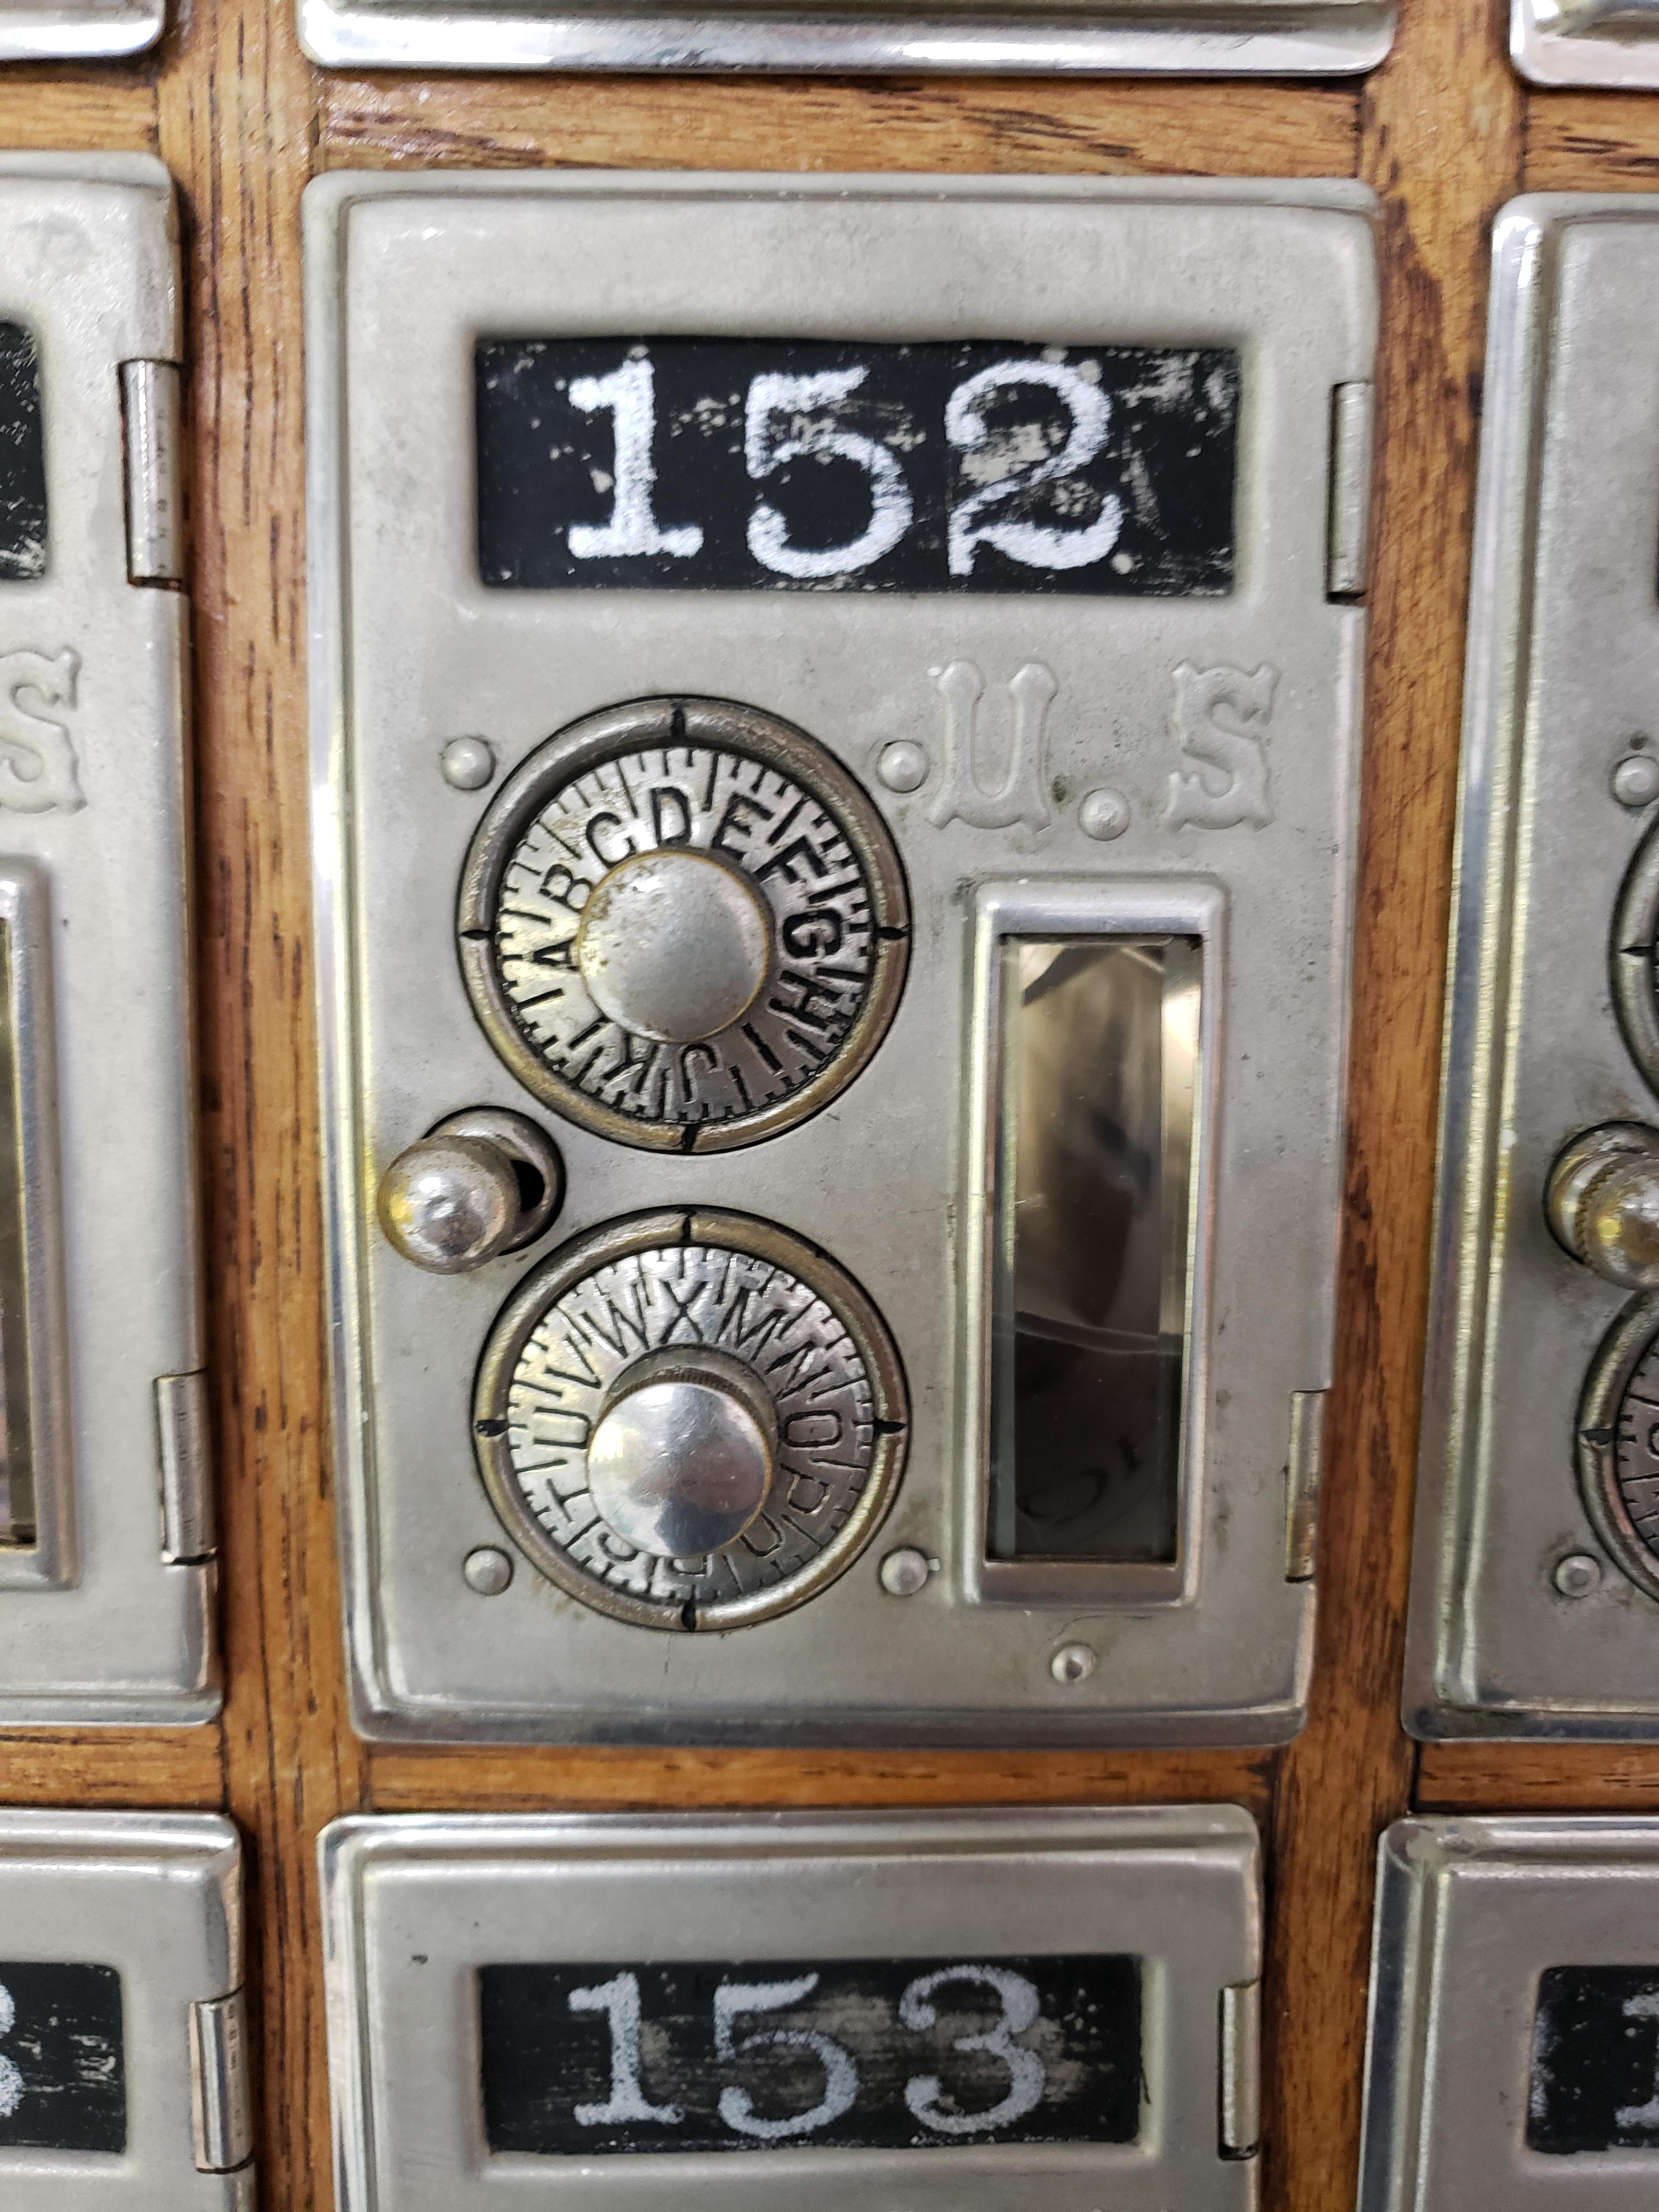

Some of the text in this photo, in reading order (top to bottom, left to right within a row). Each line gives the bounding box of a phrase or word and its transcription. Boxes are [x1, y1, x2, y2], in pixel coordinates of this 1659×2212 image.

[568, 358, 1127, 579] 152
[586, 811, 636, 868] C
[650, 786, 692, 848] D
[711, 792, 775, 861] E
[540, 863, 594, 912] B
[754, 834, 827, 884] F
[533, 938, 579, 972] A
[782, 909, 842, 958] G
[769, 970, 839, 1028] H
[680, 1043, 718, 1103] J
[659, 1278, 707, 1344] X
[533, 1406, 592, 1449] U
[780, 1409, 843, 1448] O
[567, 1965, 1045, 2139] 153
